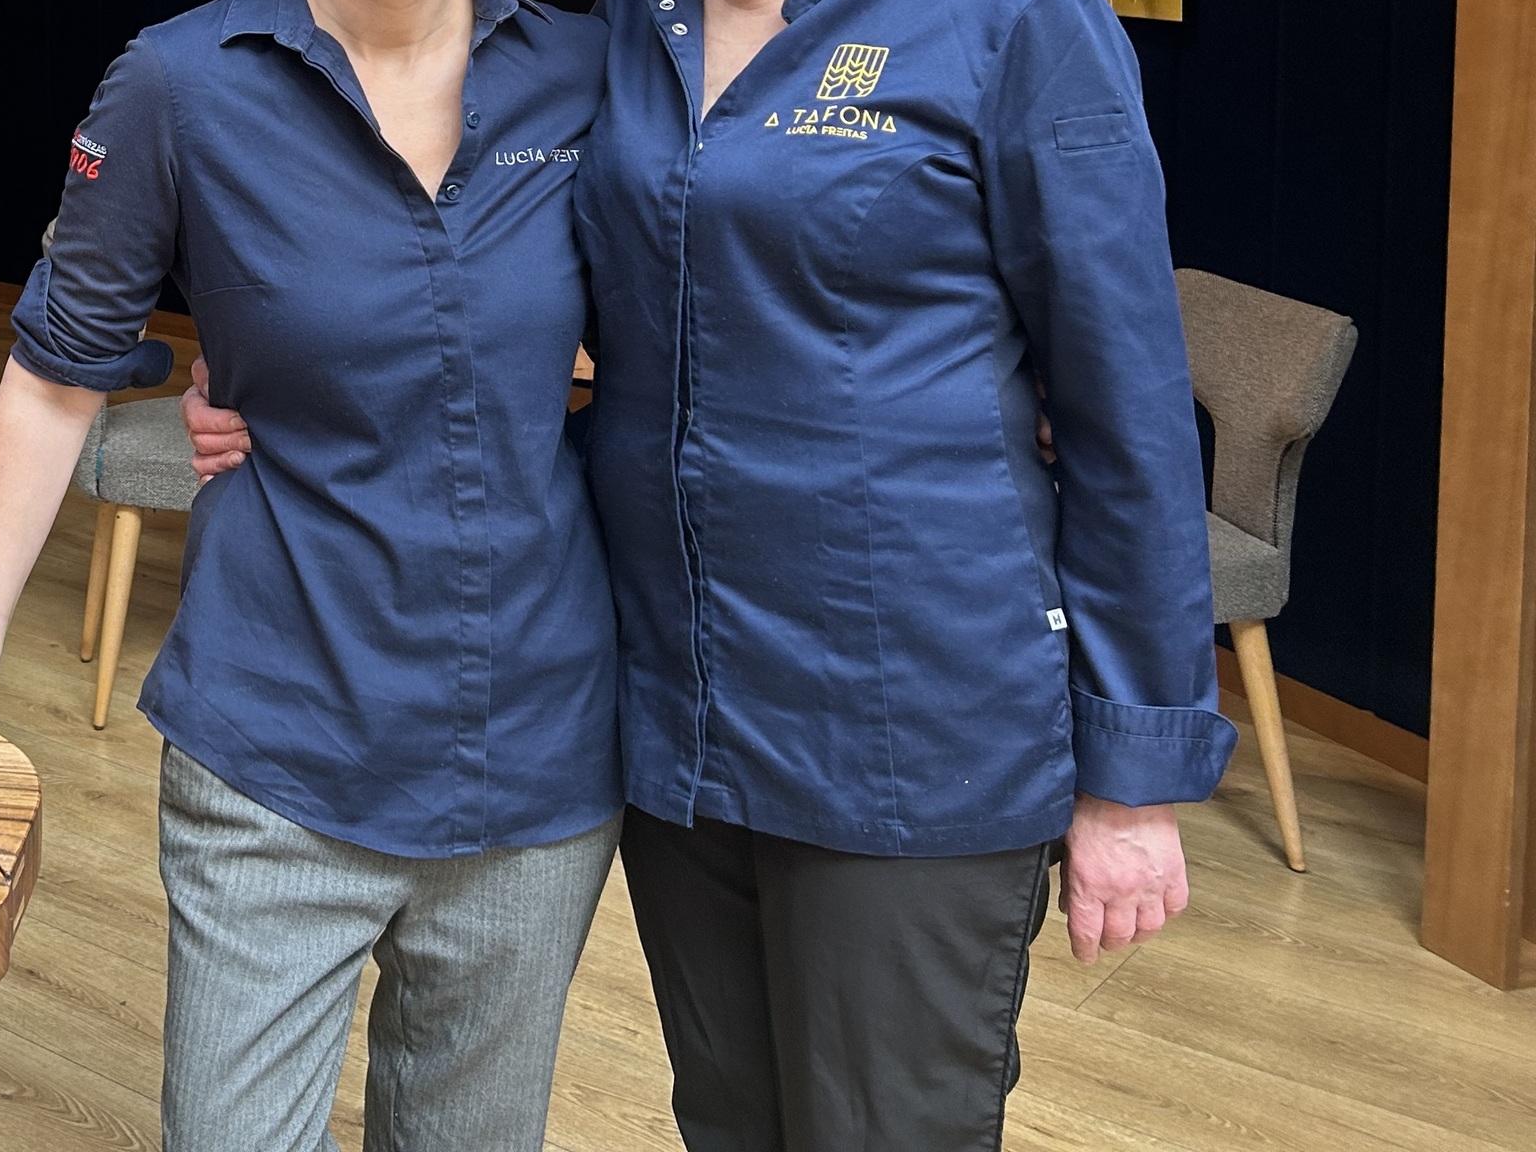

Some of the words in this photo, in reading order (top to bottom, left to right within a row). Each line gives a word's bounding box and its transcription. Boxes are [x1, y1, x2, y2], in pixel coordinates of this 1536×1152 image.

[764, 112, 779, 127] A
[792, 105, 897, 133] TAFONA
[821, 125, 868, 140] FREITAS
